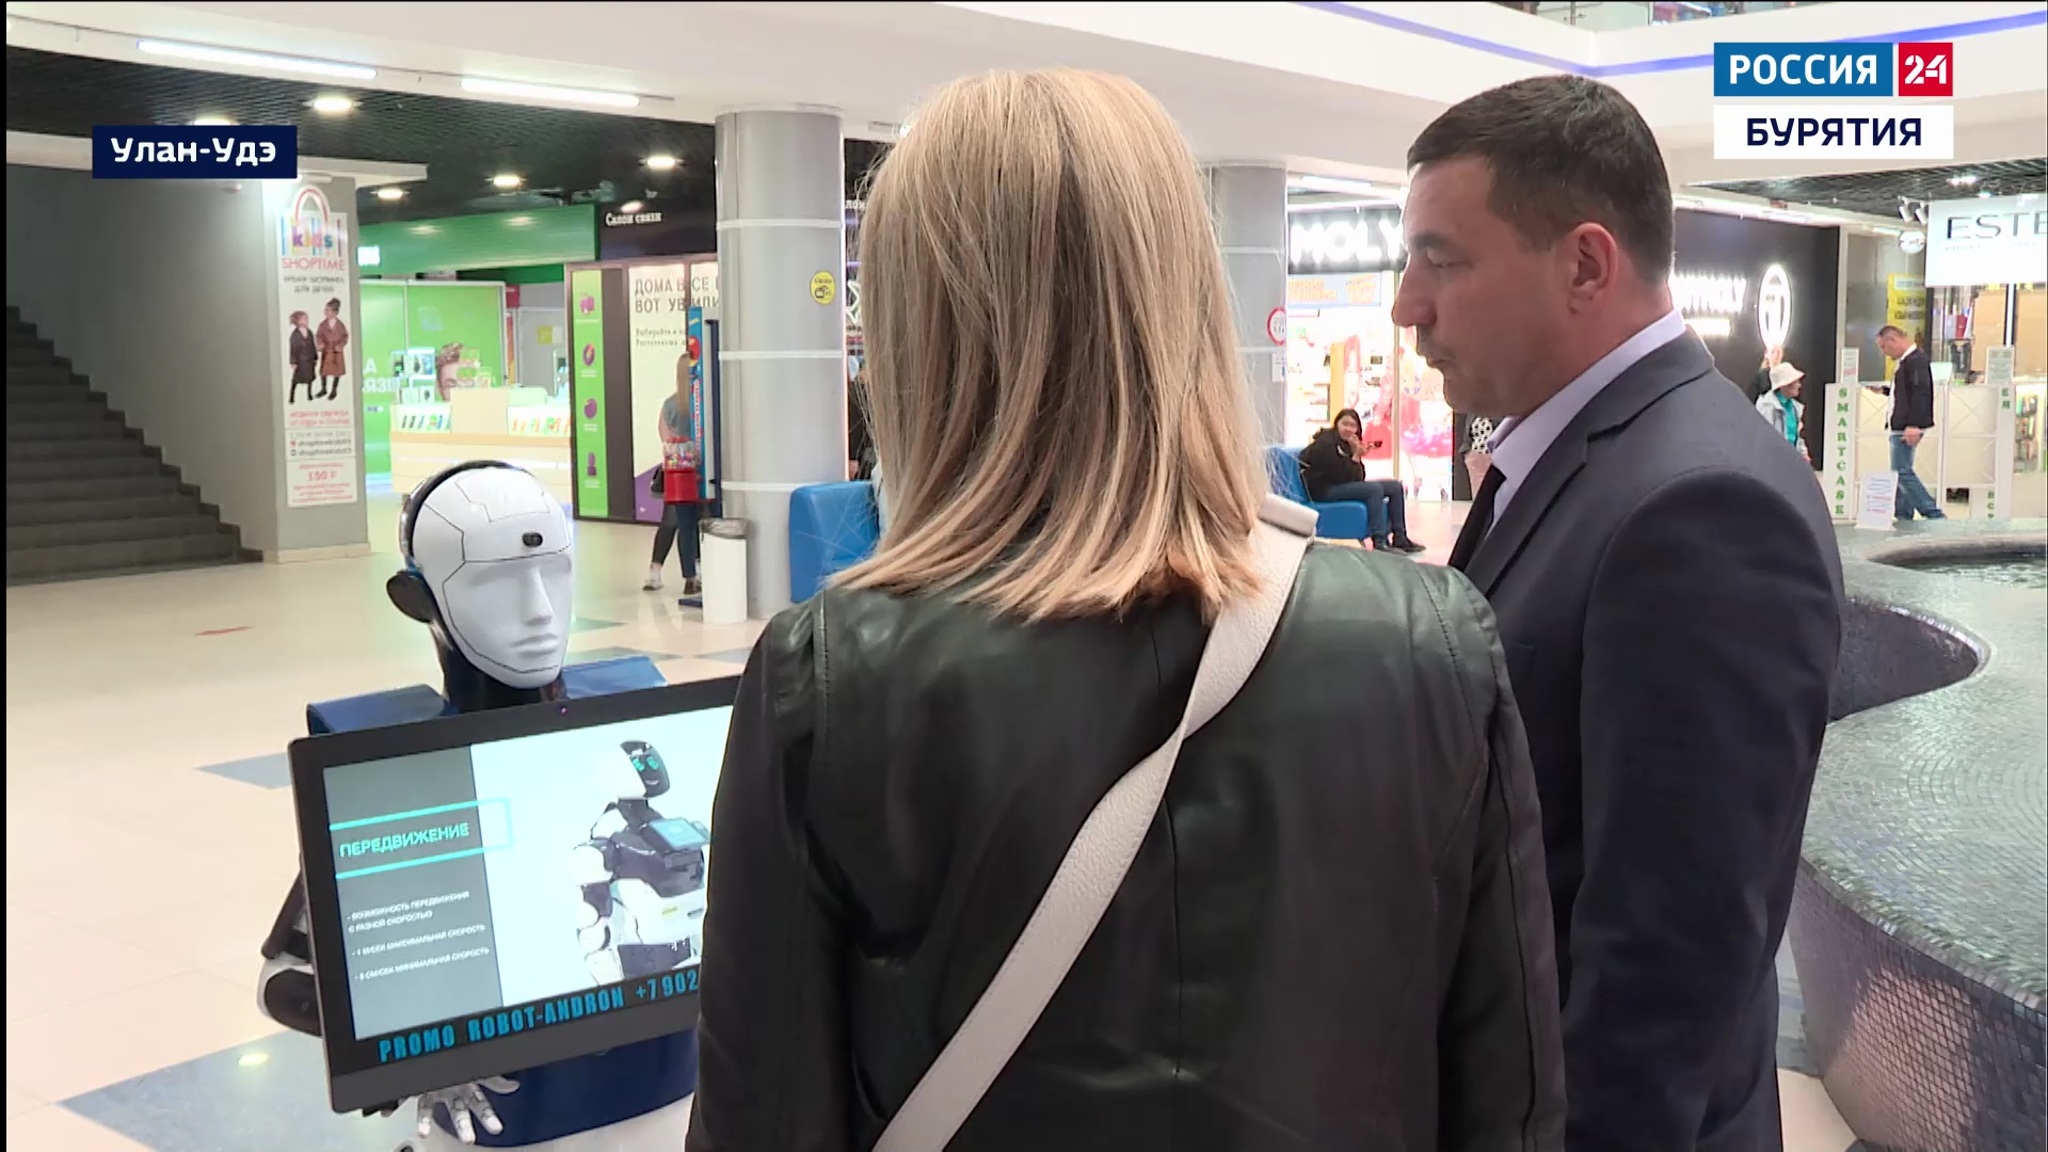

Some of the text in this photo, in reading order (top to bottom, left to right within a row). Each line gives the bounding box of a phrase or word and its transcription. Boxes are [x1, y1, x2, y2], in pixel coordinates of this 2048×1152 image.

[605, 212, 634, 226] Салон
[1290, 219, 1404, 263] MOLY
[281, 257, 345, 271] SHOPTIME
[634, 278, 673, 296] ДОМА
[635, 297, 660, 313] ВОТ
[1834, 387, 1849, 515] SMARTCASE
[339, 822, 470, 857] ПЕРЕДВИЖЕНИЕ
[378, 1024, 456, 1063] PROMO
[467, 986, 625, 1042] ROBOT-ANDRON
